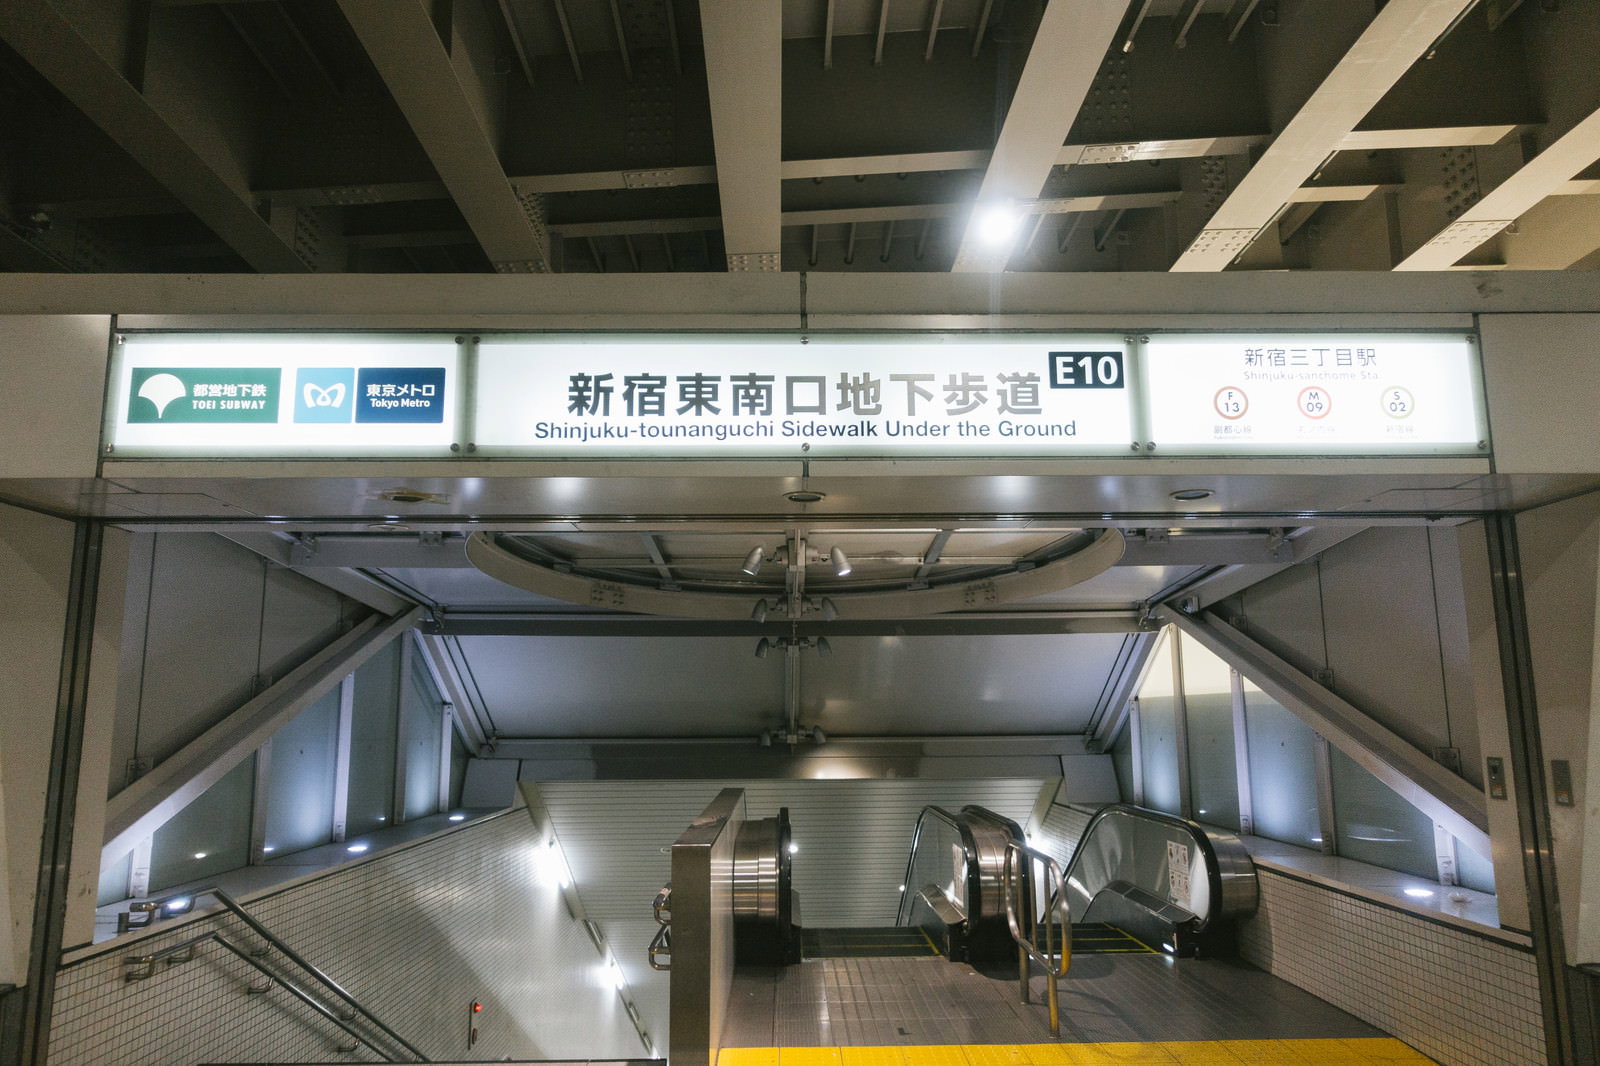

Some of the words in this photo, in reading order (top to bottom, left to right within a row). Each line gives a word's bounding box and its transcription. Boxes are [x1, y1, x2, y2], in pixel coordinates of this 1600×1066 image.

[1244, 348, 1377, 367] 新宿三丁目駅
[1055, 356, 1119, 385] E10
[1243, 371, 1356, 382] Shinjuku-sanchome
[193, 383, 267, 397] 都営地下鉄
[366, 384, 436, 397] 東京メトロ
[567, 372, 1043, 417] 新宿東南口地下歩道
[1227, 391, 1234, 401] F
[1308, 391, 1320, 401] M
[1393, 391, 1401, 401] S
[192, 400, 216, 410] TOEI
[220, 400, 265, 410] SUBWAY
[370, 398, 399, 410] Tokyo
[401, 398, 431, 408] Metro
[1223, 402, 1241, 413] 13
[1306, 402, 1324, 413] 09
[1389, 402, 1407, 413] 02
[534, 420, 774, 441] Shinjuku-tounanguchi
[781, 420, 878, 438] Sidewalk
[885, 420, 950, 438] Under
[957, 420, 991, 437] the
[998, 420, 1077, 438] Ground
